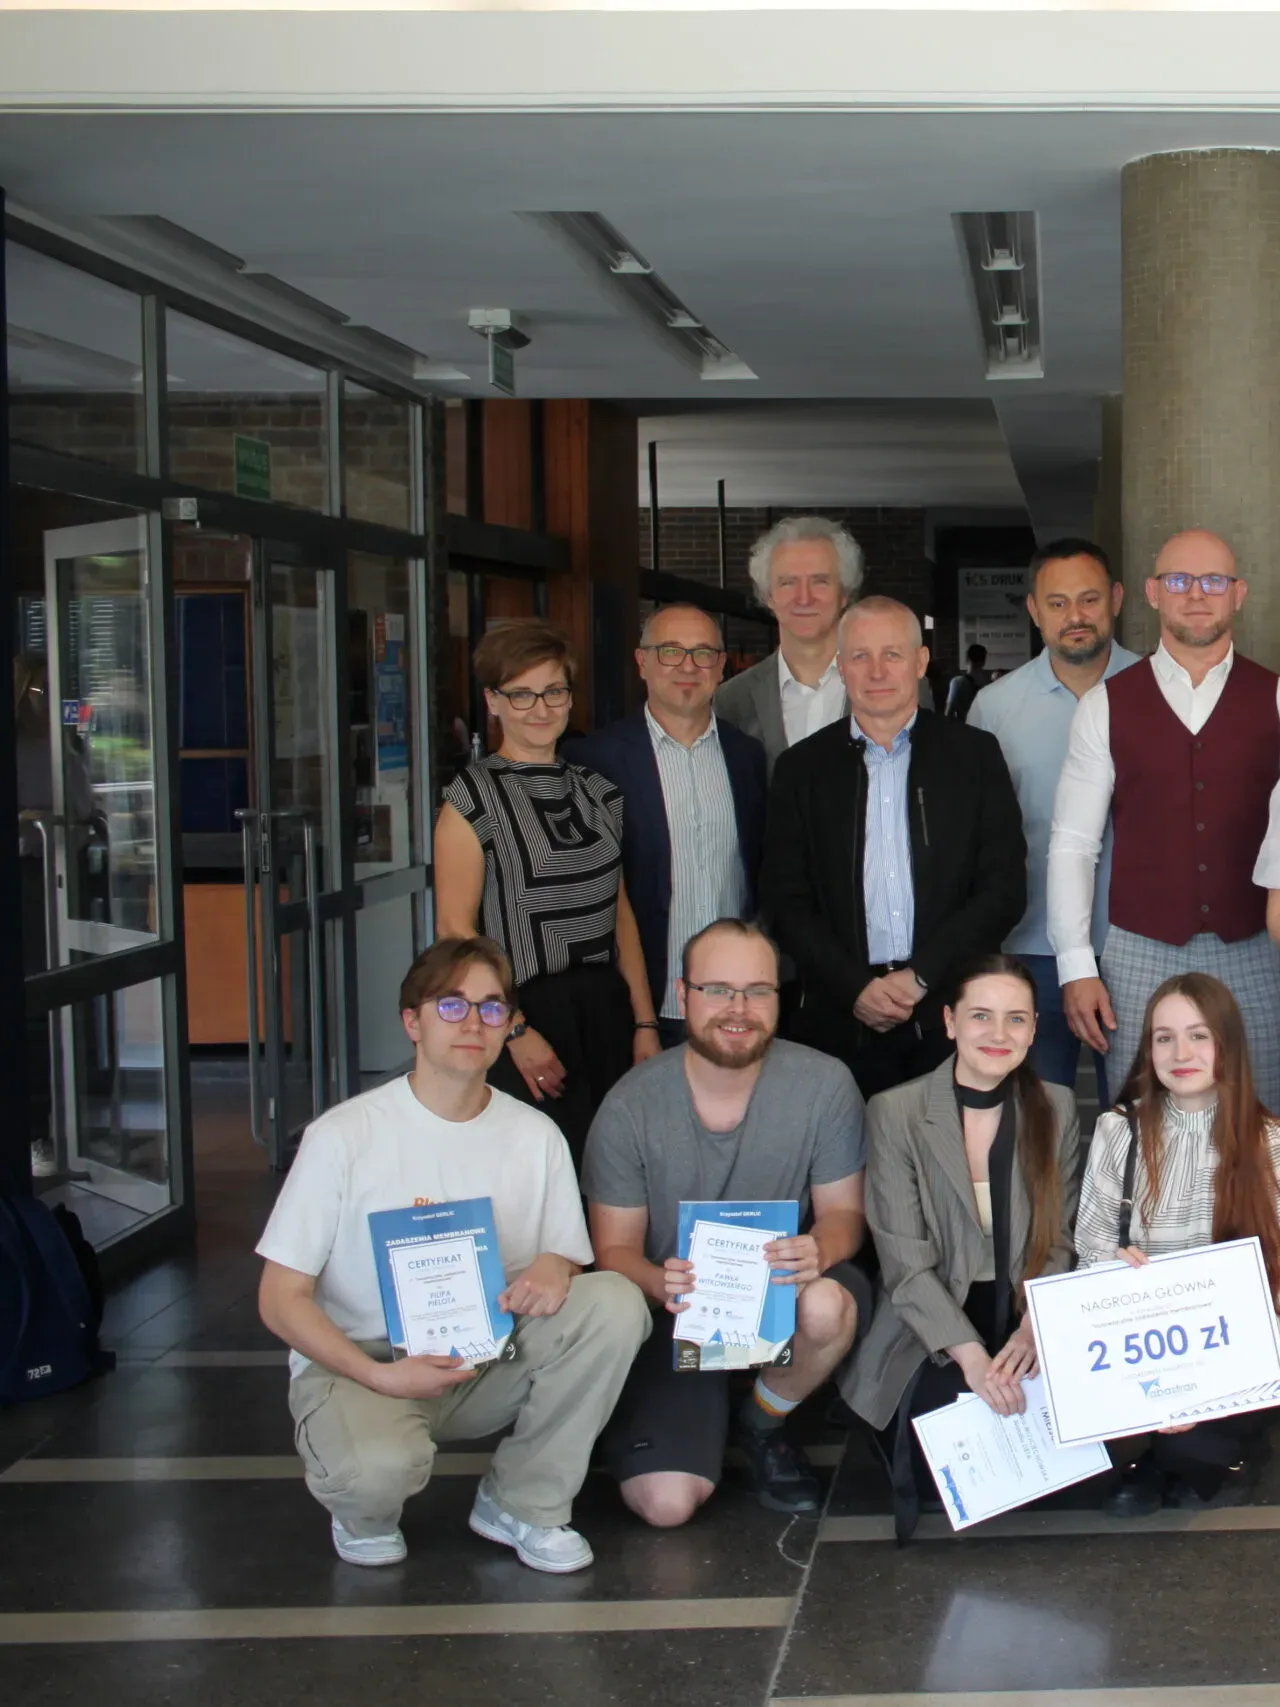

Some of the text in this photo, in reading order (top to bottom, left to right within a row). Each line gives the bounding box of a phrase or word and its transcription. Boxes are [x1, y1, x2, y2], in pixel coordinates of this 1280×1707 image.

[385, 1227, 486, 1247] ZADASZENIA MEMBRANOWE
[707, 1237, 760, 1253] CERTYFIKAT
[407, 1253, 463, 1270] CERTYFIKAT
[1081, 1291, 1152, 1314] NAGRODA
[1154, 1278, 1217, 1300] GŁÓWNA
[1087, 1340, 1111, 1372] 2
[1124, 1324, 1188, 1364] 500
[1199, 1315, 1230, 1350] zł
